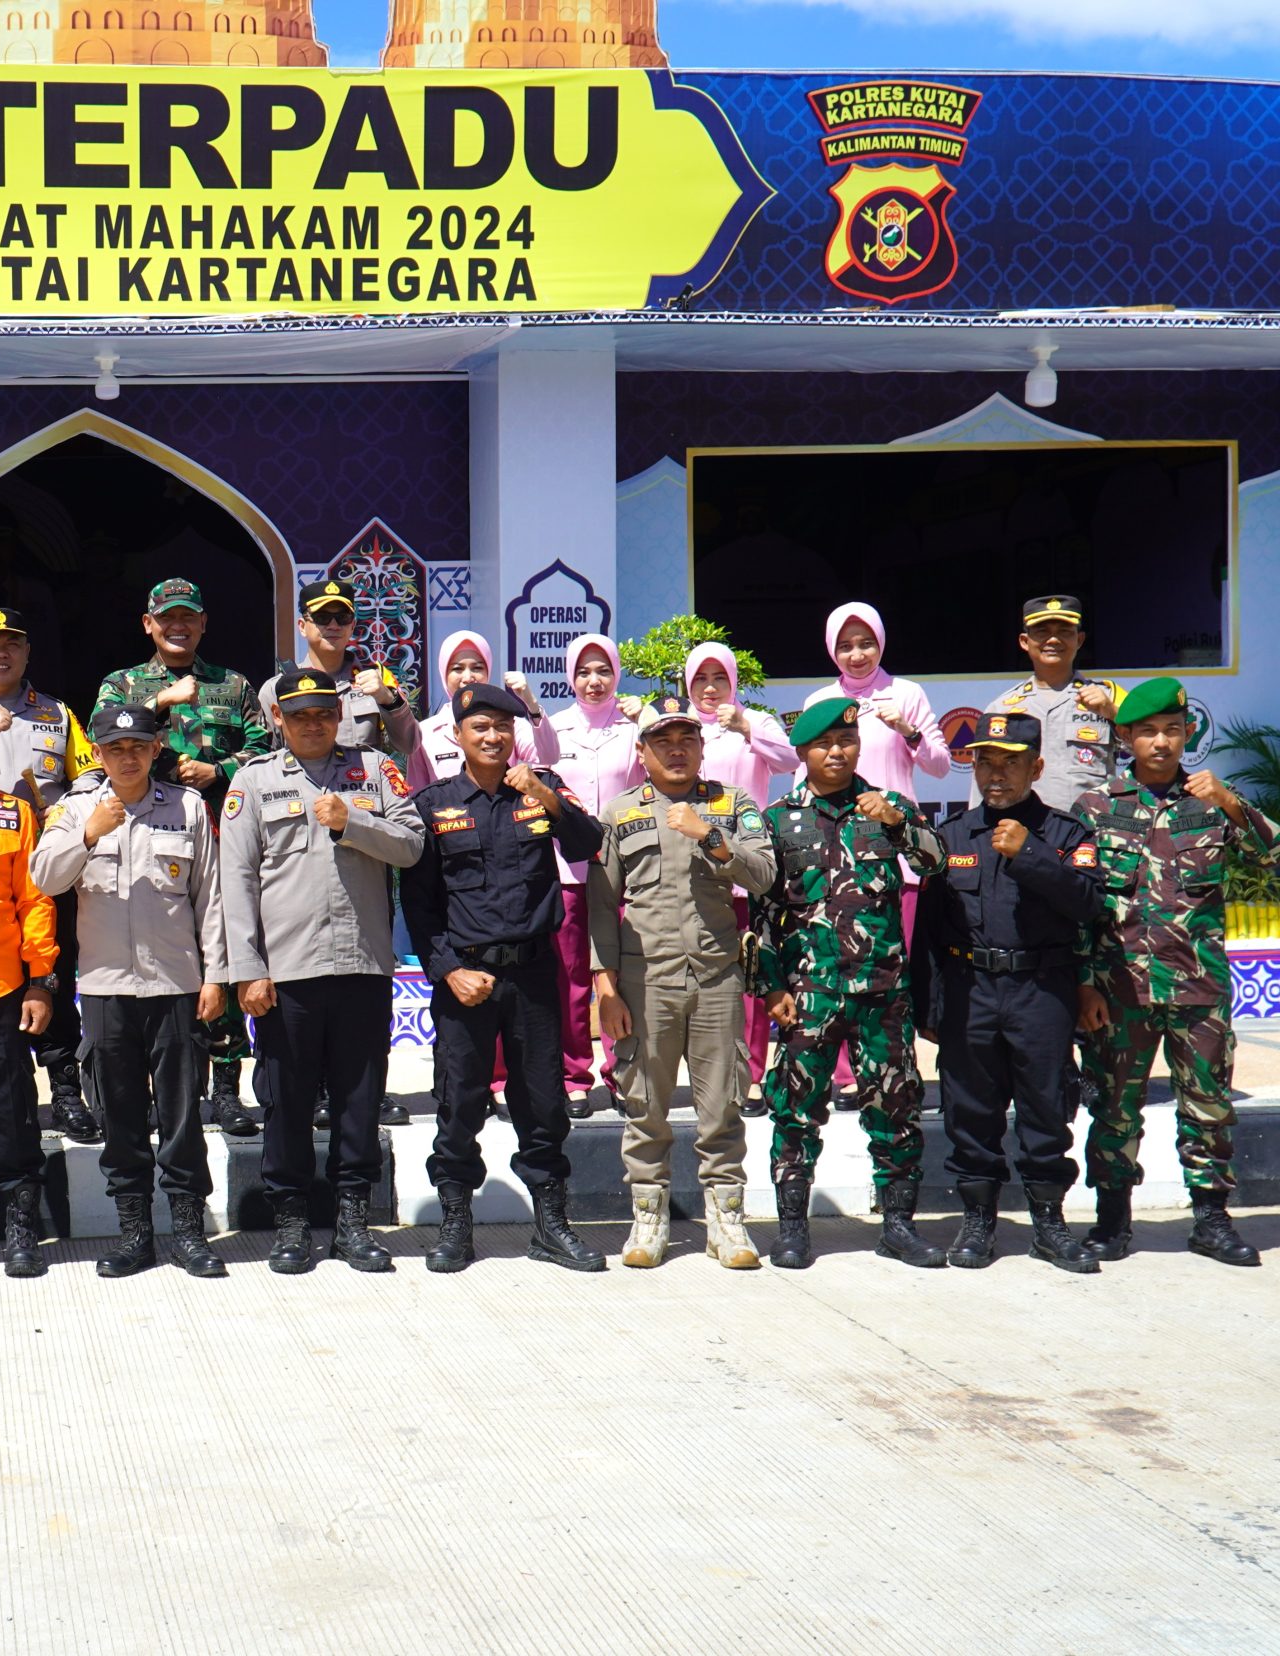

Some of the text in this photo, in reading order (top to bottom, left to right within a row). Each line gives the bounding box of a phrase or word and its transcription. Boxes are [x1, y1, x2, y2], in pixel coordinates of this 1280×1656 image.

[825, 86, 967, 111] POLRES KUTAI
[826, 102, 964, 126] KARTANEGARA
[827, 135, 962, 158] KALIMANTAN TIMUR
[95, 203, 379, 250] MAHAKAM
[406, 206, 535, 251] 2024
[118, 257, 537, 303] KARTANEGARA
[530, 606, 587, 623] OPERASI
[530, 632, 587, 649] KETUP
[522, 656, 568, 674] MAHA
[32, 724, 64, 734] POLRI
[341, 782, 380, 793] POLRI
[152, 824, 194, 833] POLRI
[438, 820, 468, 832] IRFAN
[623, 820, 651, 834] ANDY
[703, 816, 723, 825] POL
[948, 856, 974, 865] TOYO
